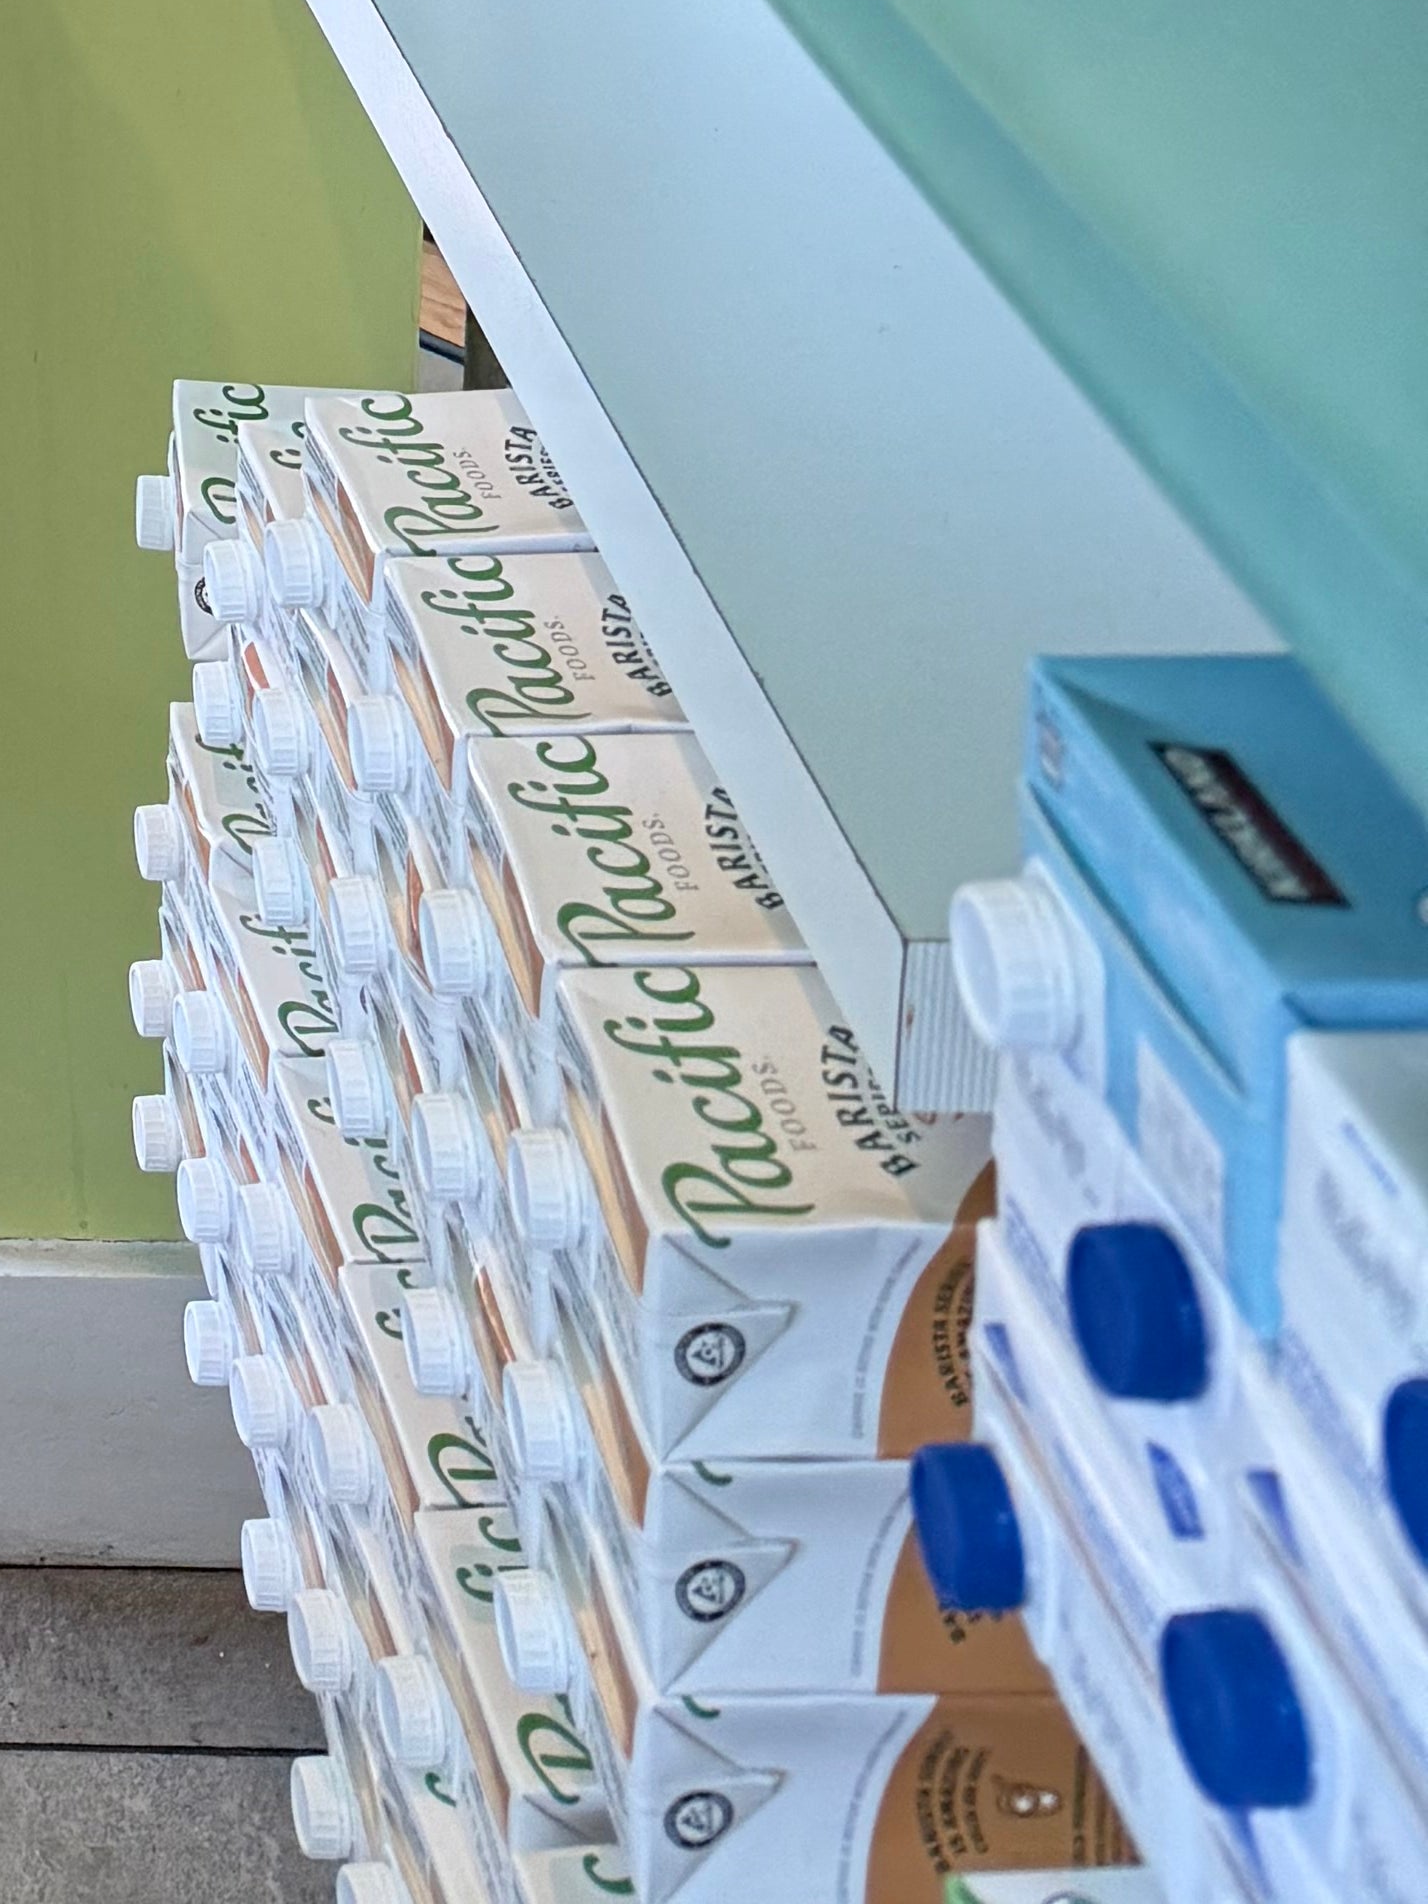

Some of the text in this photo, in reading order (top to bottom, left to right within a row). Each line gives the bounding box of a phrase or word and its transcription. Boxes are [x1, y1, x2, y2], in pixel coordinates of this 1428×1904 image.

[339, 393, 501, 557] Pacific
[504, 425, 574, 510] BARISTA
[421, 555, 592, 736] Pacific
[507, 735, 696, 968] Pacific
[603, 966, 816, 1249] Pacific
[820, 1024, 922, 1178] BARISTA
